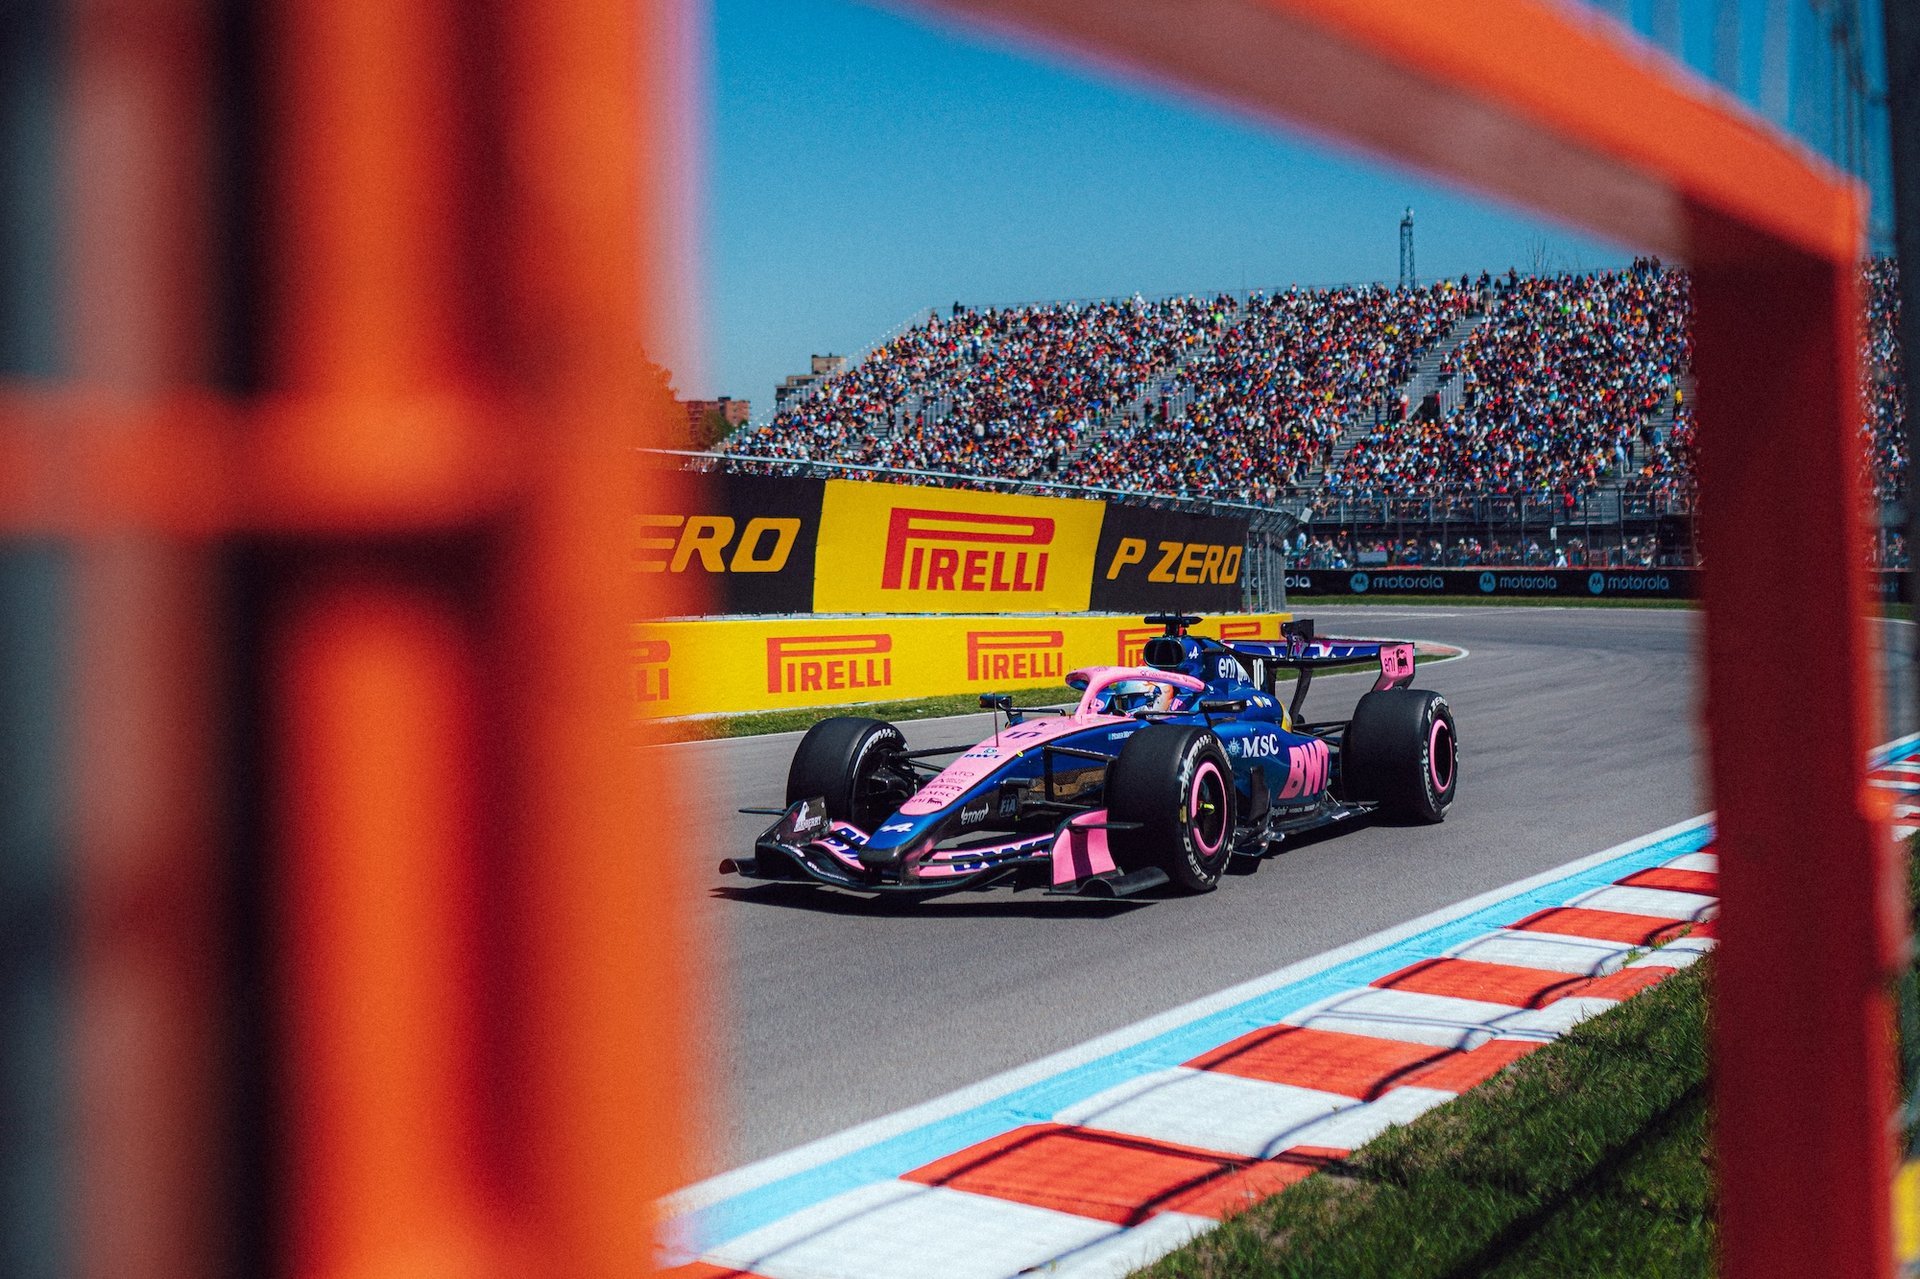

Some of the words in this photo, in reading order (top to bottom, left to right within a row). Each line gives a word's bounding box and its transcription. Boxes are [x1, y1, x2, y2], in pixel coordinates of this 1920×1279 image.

[628, 513, 802, 573] ERO
[881, 507, 1056, 592] PIRELLI
[1106, 537, 1147, 580] P
[1148, 541, 1243, 584] ZERO
[1373, 574, 1445, 589] motorola
[1500, 574, 1557, 590] motorola
[1608, 574, 1670, 591] motorola
[766, 633, 893, 694] PIRELLI
[967, 630, 1064, 681] PIRELLI
[1241, 733, 1279, 759] MSC
[1278, 738, 1330, 800] BWT
[1000, 798, 1017, 814] FIA
